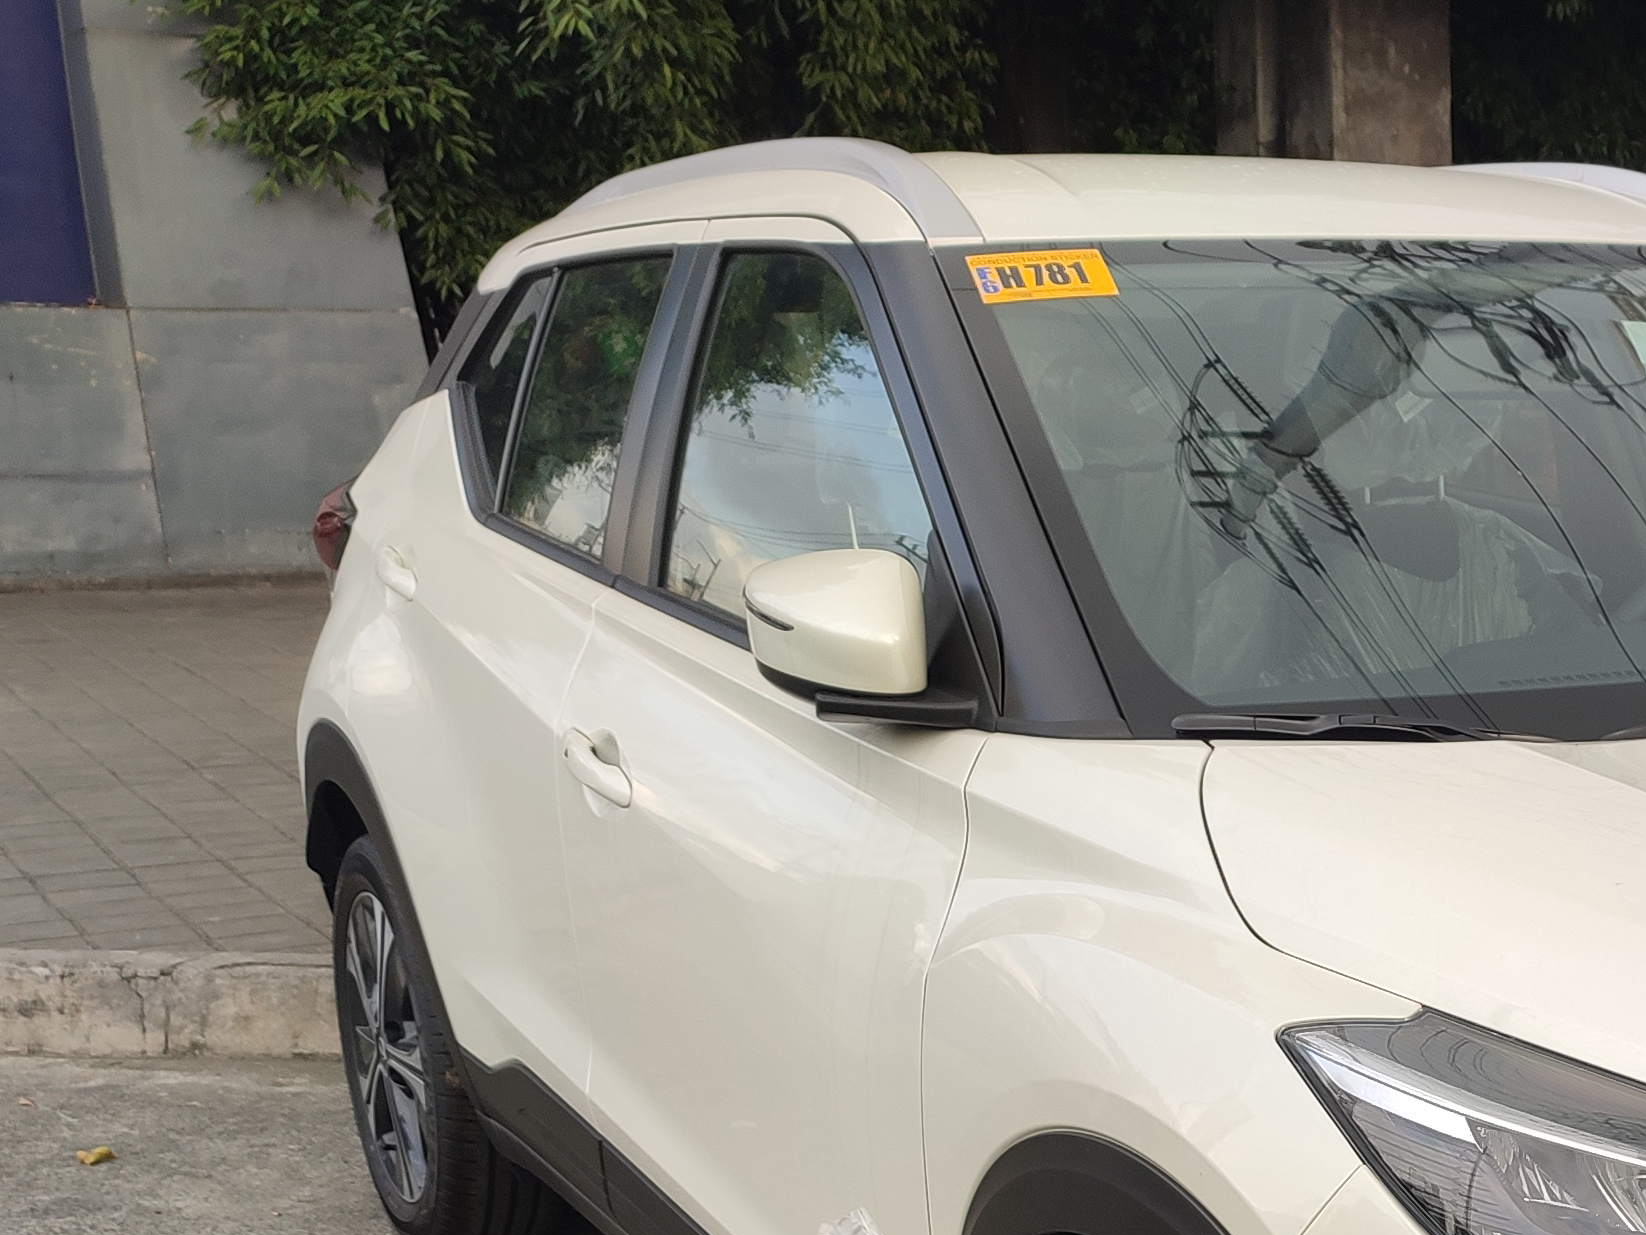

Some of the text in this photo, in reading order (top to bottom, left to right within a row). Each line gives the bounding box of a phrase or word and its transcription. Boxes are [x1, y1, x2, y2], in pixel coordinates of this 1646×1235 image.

[968, 251, 1100, 267] CONDUCTION STICKER
[995, 261, 1091, 290] H781
